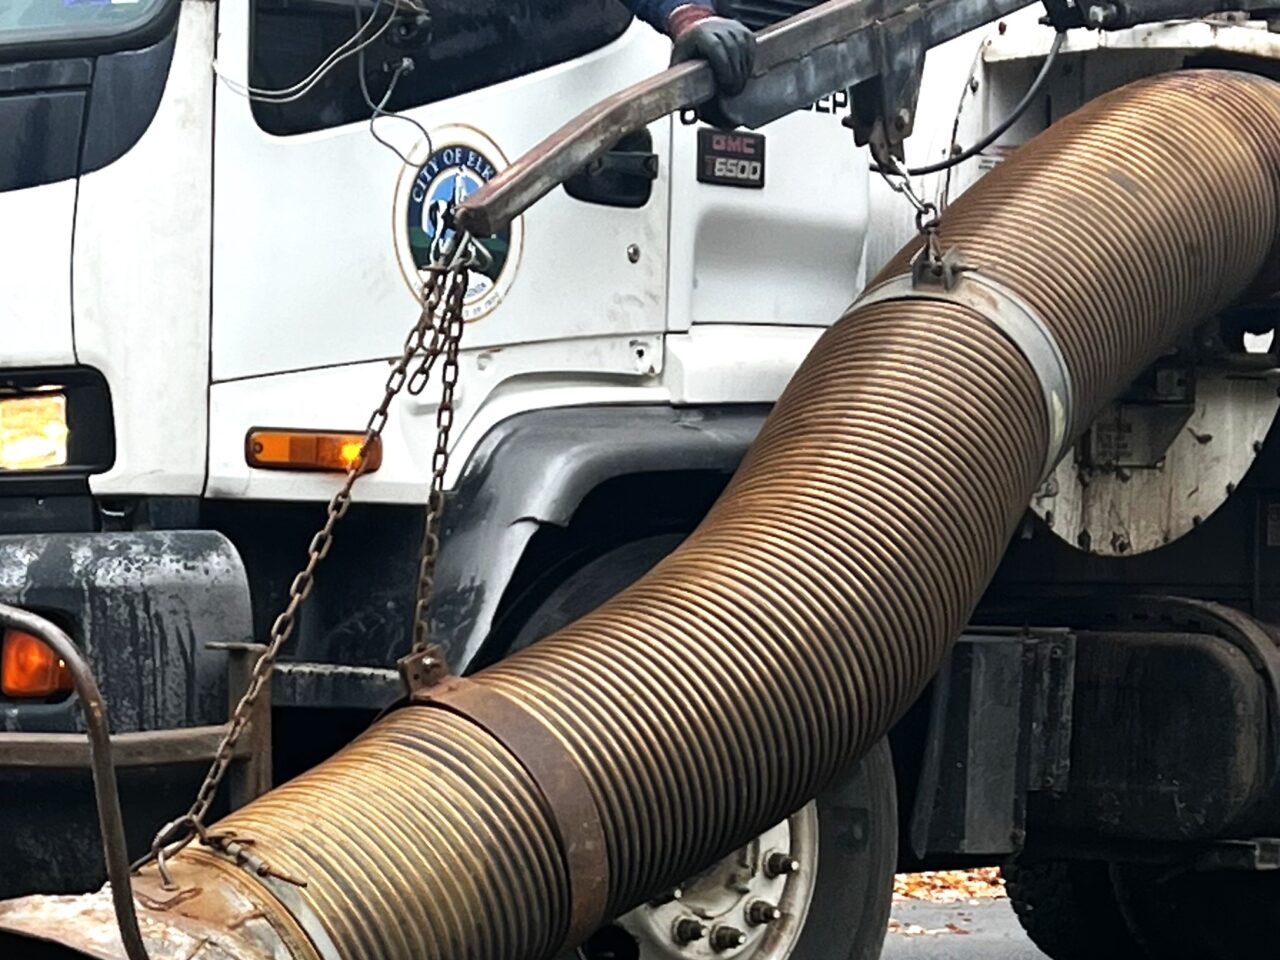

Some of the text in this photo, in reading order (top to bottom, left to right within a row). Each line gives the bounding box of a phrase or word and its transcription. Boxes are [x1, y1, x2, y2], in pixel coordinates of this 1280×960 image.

[711, 134, 756, 155] GMC
[412, 147, 495, 203] CITY OF ELK
